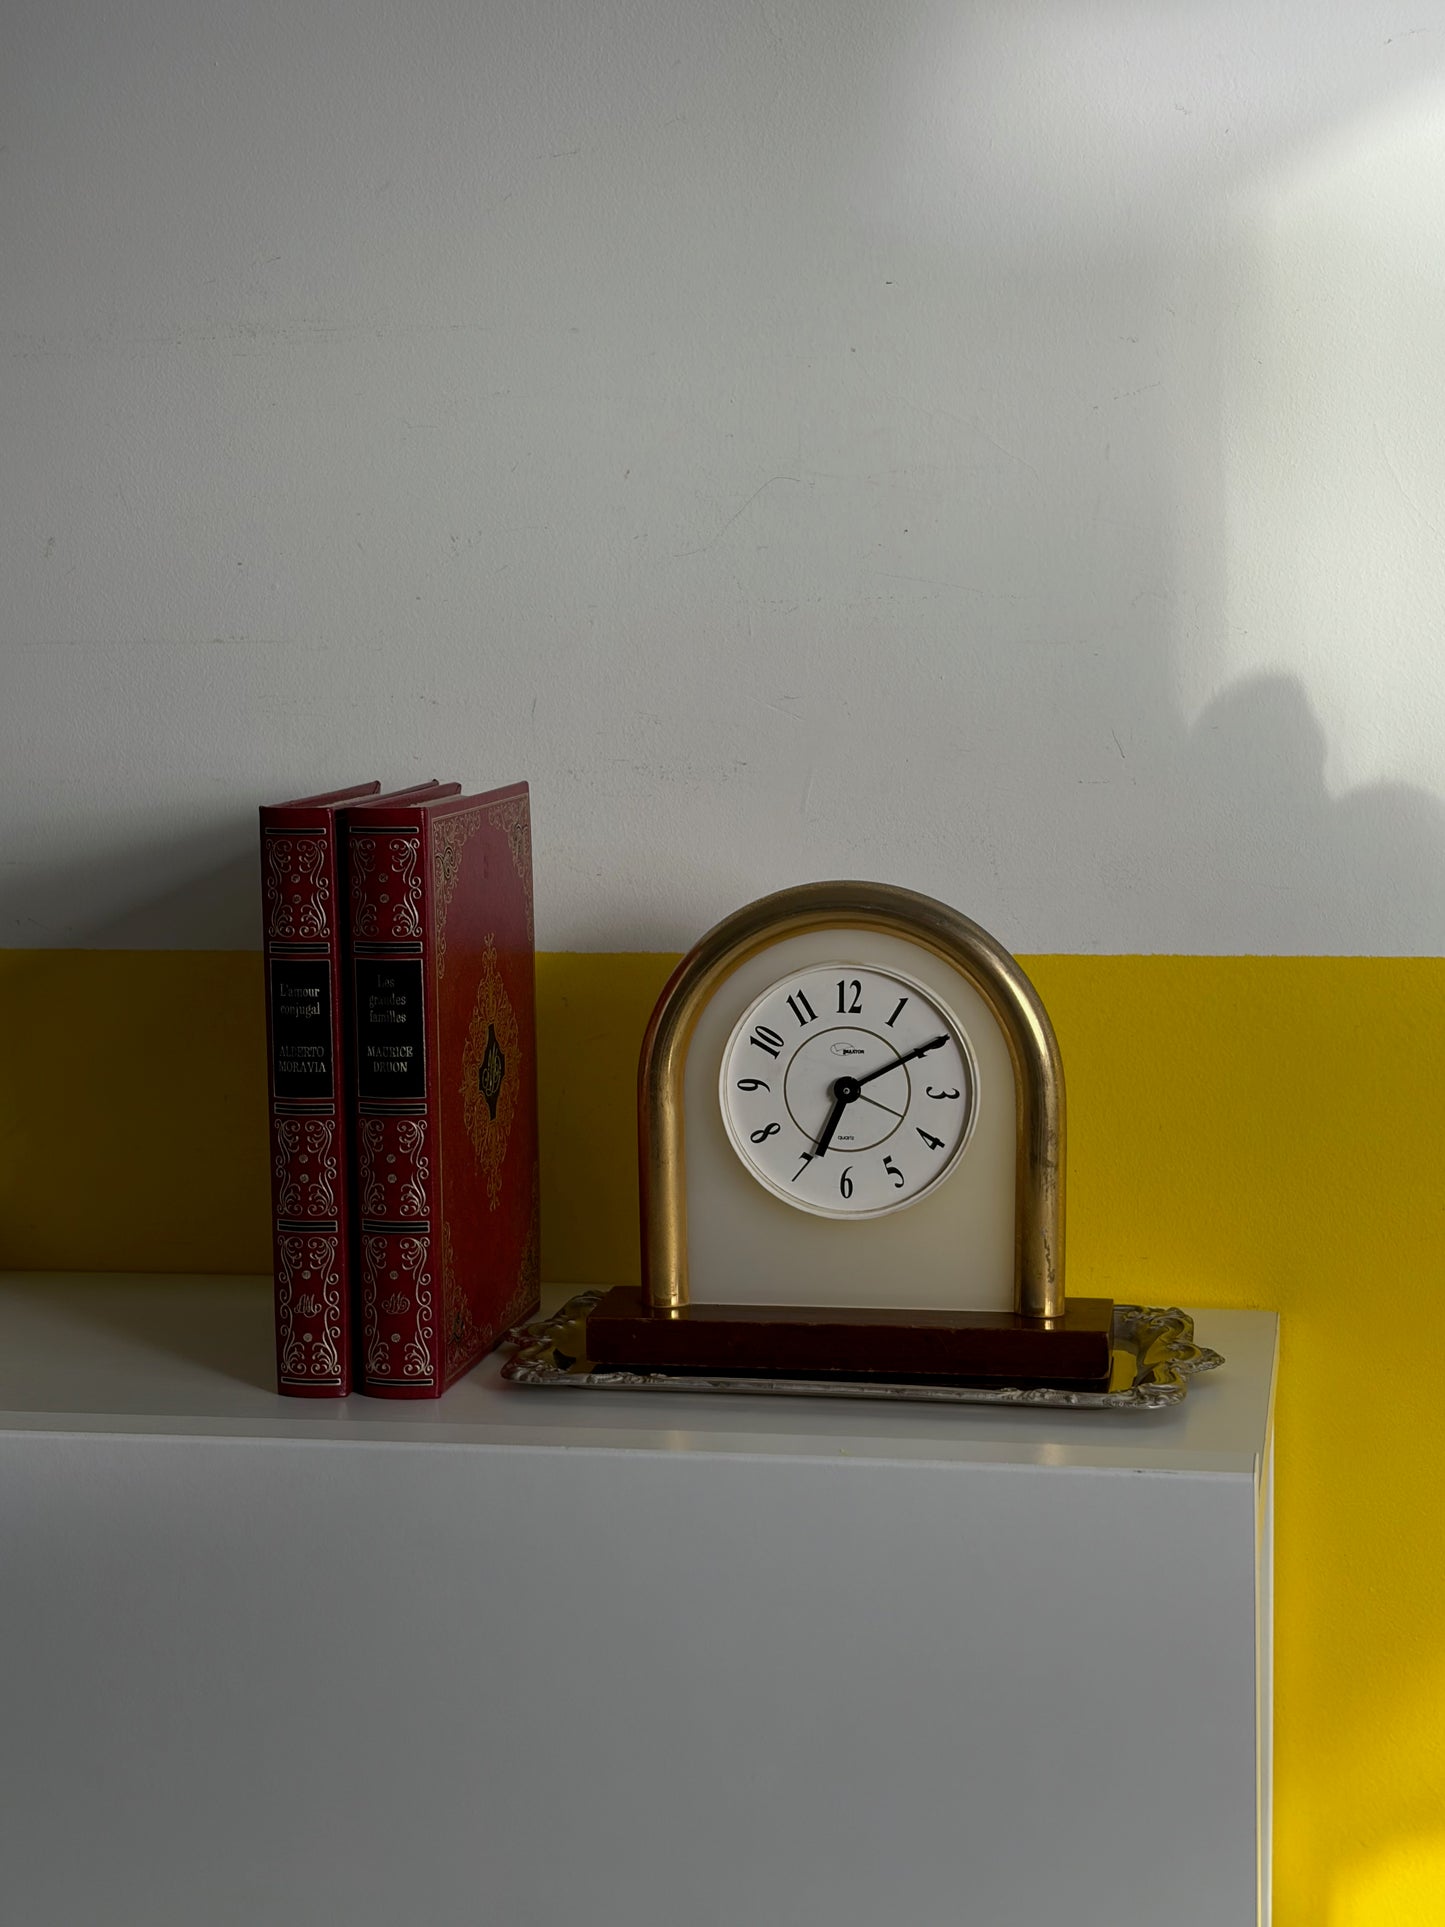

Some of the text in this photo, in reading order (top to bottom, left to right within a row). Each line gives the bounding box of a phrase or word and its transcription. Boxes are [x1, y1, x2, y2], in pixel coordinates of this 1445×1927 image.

[377, 974, 395, 988] Les
[280, 983, 320, 998] L'amour
[836, 979, 863, 1014] 12
[280, 1002, 321, 1018] conjugal
[785, 989, 819, 1027] 11
[884, 997, 909, 1028] 1
[369, 1010, 407, 1023] familles
[749, 1025, 785, 1060] 10
[279, 1046, 325, 1058] ALBERTO
[367, 1046, 413, 1058] MAURICE
[279, 1061, 327, 1073] MORAVIA
[373, 1061, 408, 1073] DRUON
[736, 1078, 771, 1093] 9
[925, 1086, 960, 1100] 3
[750, 1122, 781, 1144] 8
[915, 1127, 945, 1150] 4
[791, 1151, 814, 1182] 7
[882, 1155, 905, 1188] 5
[839, 1165, 854, 1199] 6
